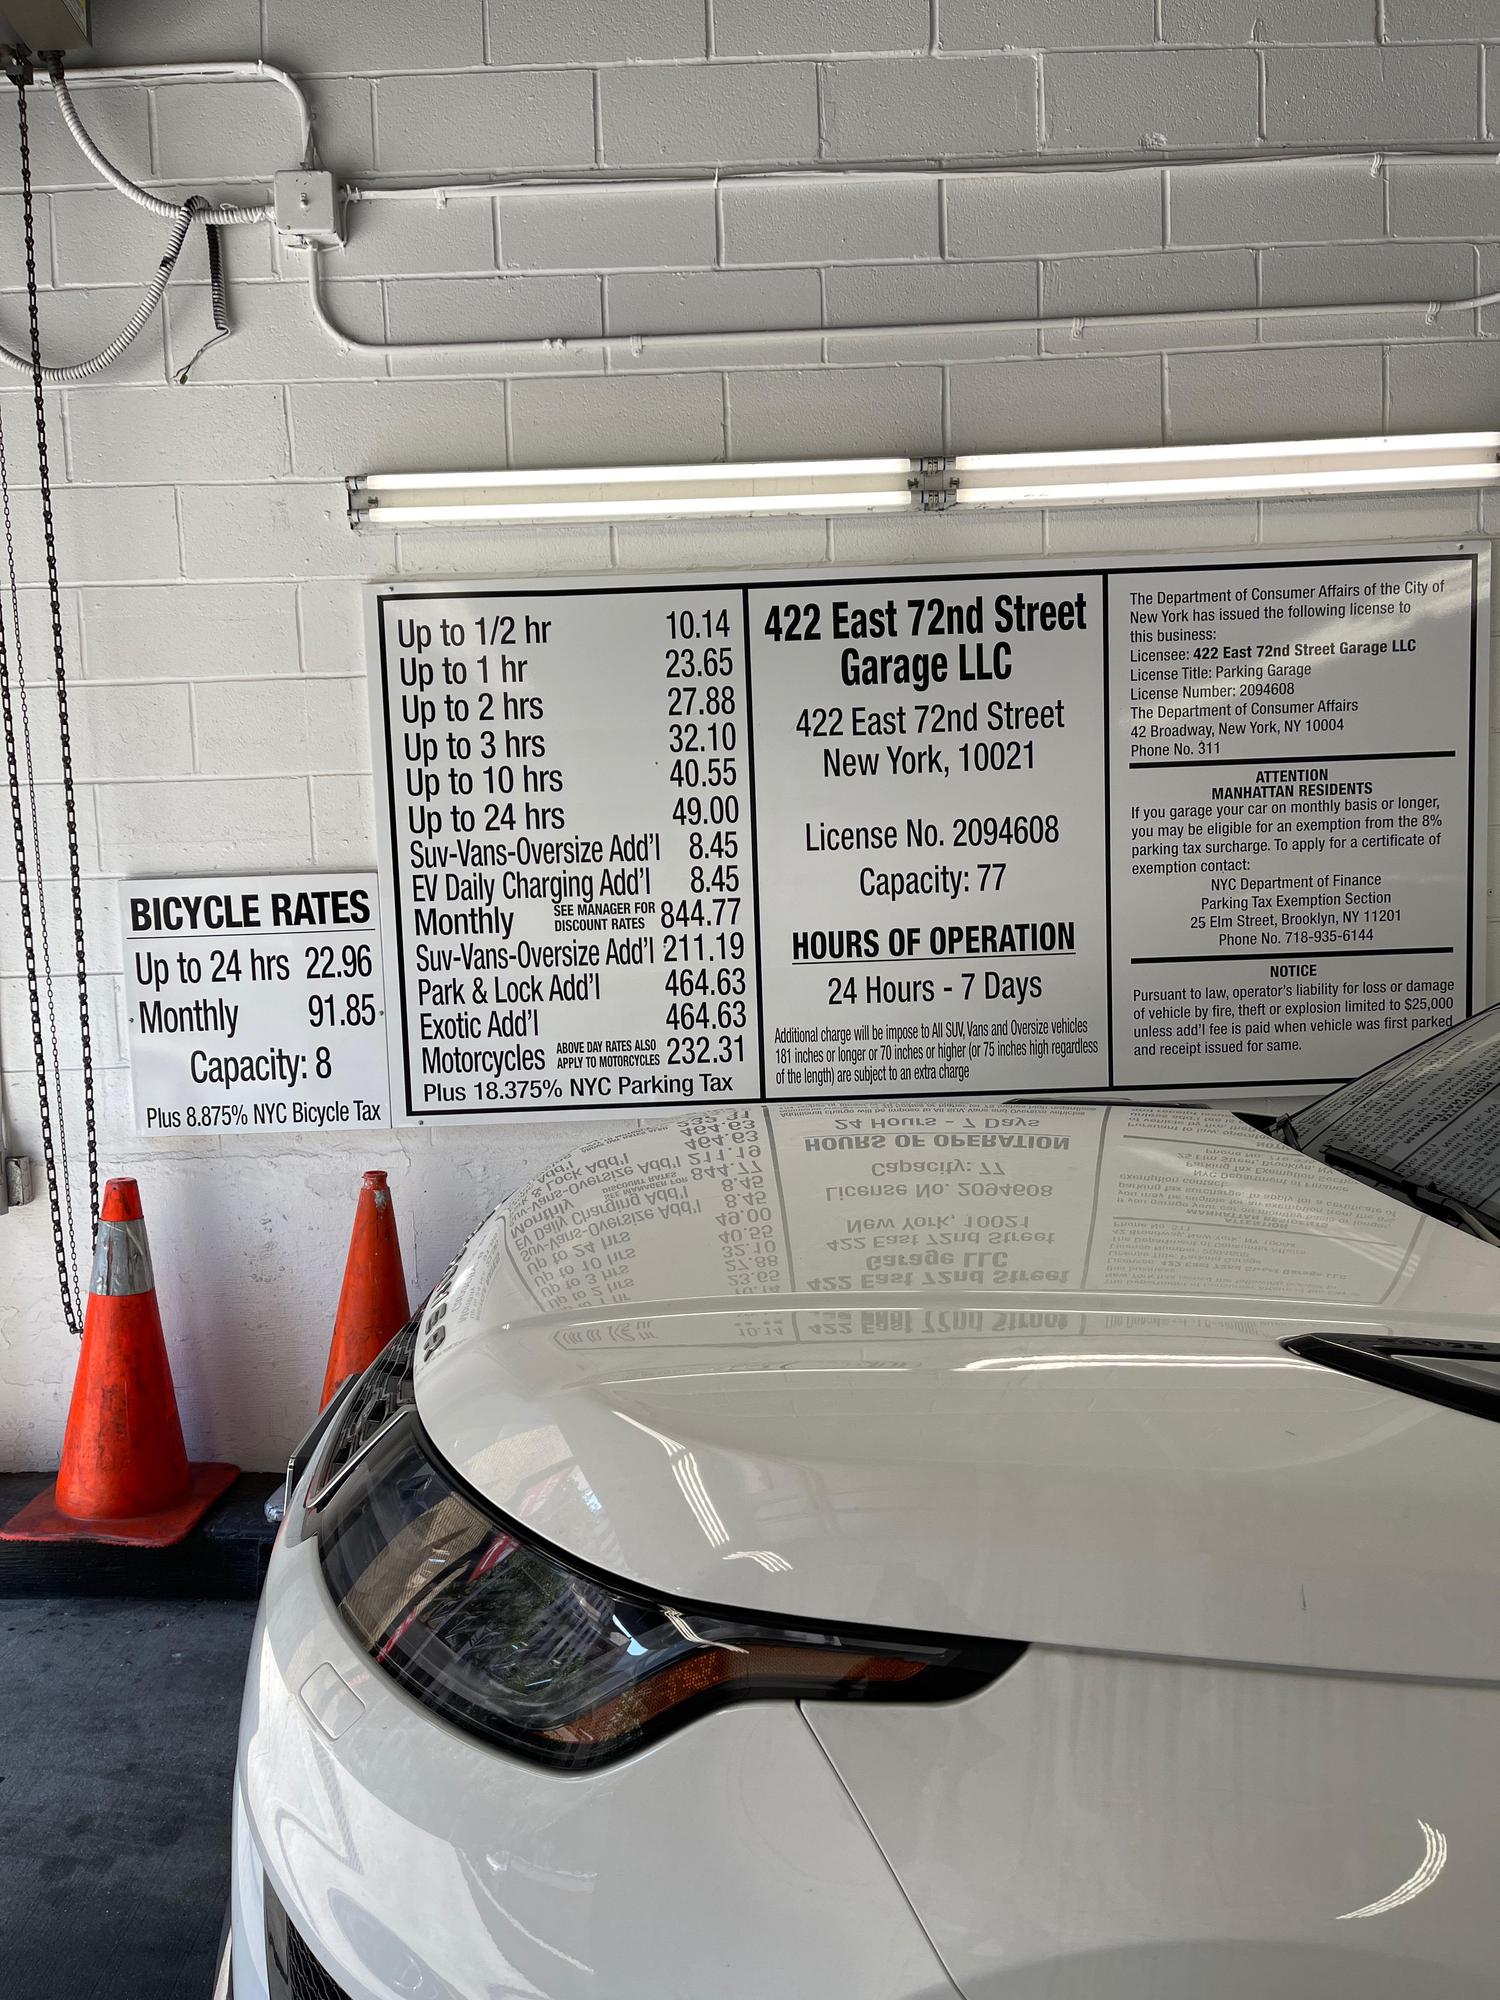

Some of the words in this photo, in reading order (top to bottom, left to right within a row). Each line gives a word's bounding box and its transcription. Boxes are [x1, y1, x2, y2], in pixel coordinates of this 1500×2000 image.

[1129, 592, 1153, 605] The
[1157, 589, 1232, 607] Department
[1235, 588, 1248, 601] of
[1251, 587, 1316, 601] Consumer
[1318, 584, 1360, 598] Affairs
[1364, 582, 1377, 596] of
[1380, 582, 1400, 595] the
[1405, 581, 1428, 596] City
[1432, 579, 1445, 593] of
[397, 619, 432, 654] Up
[439, 619, 465, 647] to
[474, 615, 516, 646] 1/2
[525, 615, 552, 644] hr
[666, 609, 731, 640] 10.14
[764, 603, 821, 642] 422
[832, 600, 898, 640] East
[907, 595, 984, 636] 72nd
[994, 592, 1087, 633] Street
[841, 647, 948, 692] Garage
[959, 641, 1012, 681] LLC
[1130, 649, 1189, 662] Licensee:
[1193, 647, 1219, 660] 422
[1223, 645, 1252, 659] East
[1256, 644, 1290, 658] 72nd
[1294, 642, 1335, 656] Street
[1339, 642, 1388, 656] Garage
[1392, 639, 1416, 652] LLC
[399, 657, 434, 692] Up
[441, 657, 467, 685] to
[477, 655, 488, 684] 1
[501, 654, 528, 683] hr
[665, 647, 733, 679] 23.65
[1131, 687, 1179, 701] License
[1183, 685, 1236, 698] Number:
[1240, 682, 1295, 697] 2094608
[796, 707, 844, 737] 422
[851, 706, 907, 736] East
[914, 702, 978, 734] 72nd
[987, 699, 1065, 731] Street
[404, 732, 438, 768] Up
[445, 732, 471, 760] to
[480, 730, 496, 759] 3
[505, 729, 546, 758] hrs
[669, 722, 736, 753] 32.10
[823, 748, 880, 777] New
[886, 744, 949, 778] York,
[958, 740, 1033, 772] 10021
[1131, 744, 1170, 757] Phone
[1174, 742, 1194, 756] No.
[1198, 740, 1219, 755] 311
[1212, 784, 1294, 800] MANHATTAN
[1299, 781, 1373, 797] RESIDENTS
[1255, 768, 1328, 784] ATTENTION
[806, 822, 898, 851] License
[906, 818, 944, 848] No.
[953, 814, 1059, 847] 2094608
[412, 873, 438, 902] EV
[445, 872, 495, 907] Daily
[502, 869, 594, 904] Charging
[599, 867, 651, 896] Add'l
[690, 864, 739, 894] 8.45
[860, 864, 969, 902] Capacity:
[977, 863, 1007, 892] 77
[130, 894, 261, 931] BICYCLE
[271, 889, 370, 927] RATES
[414, 906, 514, 940] Monthly
[661, 897, 741, 929] 844.77
[553, 904, 574, 917] SEE
[577, 902, 631, 916] MANAGER
[634, 901, 656, 914] FOR
[554, 918, 608, 932] DISCOUNT
[611, 917, 645, 930] RATES
[1190, 916, 1206, 929] 25
[1210, 915, 1233, 928] Elm
[1237, 914, 1278, 928] Street,
[1281, 912, 1339, 927] Brooklyn,
[1343, 910, 1360, 923] NY
[1364, 909, 1400, 922] 11201
[792, 929, 880, 960] HOURS
[888, 927, 921, 957] OF
[929, 921, 1075, 954] OPERATION
[1219, 933, 1257, 946] Phone
[1261, 932, 1281, 945] No.
[1285, 928, 1374, 944] 718-935-6144
[135, 952, 169, 992] Up
[176, 952, 202, 984] to
[210, 949, 242, 983] 24
[250, 948, 290, 981] hrs
[305, 944, 372, 979] 22.96
[418, 977, 466, 1006] Park
[472, 977, 489, 1005] &
[494, 974, 544, 1003] Lock
[548, 972, 600, 1002] Add'l
[665, 967, 746, 997] 464.63
[1270, 964, 1317, 978] NOTICE
[828, 976, 858, 1005] 24
[866, 975, 935, 1006] Hours
[961, 972, 975, 1000] 7
[984, 971, 1042, 1005] Days
[139, 998, 239, 1039] Monthly
[308, 993, 376, 1028] 91.85
[420, 1011, 482, 1040] Exotic
[487, 1009, 539, 1038] Add'l
[666, 1000, 747, 1030] 464.63
[422, 1043, 546, 1078] Motorcycles
[666, 1034, 744, 1065] 232.31
[556, 1041, 585, 1054] ABOVE
[586, 1041, 603, 1053] DAY
[605, 1039, 632, 1053] RATES
[634, 1038, 657, 1052] ALSO
[557, 1056, 584, 1069] APPLY
[585, 1056, 597, 1068] TO
[599, 1053, 661, 1068] MOTORCYCLES
[191, 1047, 307, 1090] Capacity:
[316, 1046, 332, 1079] 8
[776, 1068, 785, 1085] of
[787, 1068, 802, 1084] the
[804, 1067, 835, 1087] length)
[837, 1070, 852, 1083] are
[854, 1065, 887, 1085] subject
[888, 1065, 898, 1081] to
[900, 1067, 911, 1080] an
[914, 1064, 937, 1080] extra
[939, 1063, 969, 1082] charge
[423, 1083, 466, 1102] Plus
[473, 1079, 563, 1100] 18.375%
[570, 1076, 611, 1097] NYC
[618, 1074, 694, 1097] Parking
[698, 1073, 734, 1092] Tax
[146, 1107, 181, 1128] Plus
[186, 1104, 248, 1127] 8.875%
[253, 1102, 287, 1125] NYC
[292, 1100, 349, 1127] Bicycle
[353, 1100, 381, 1121] Tax
